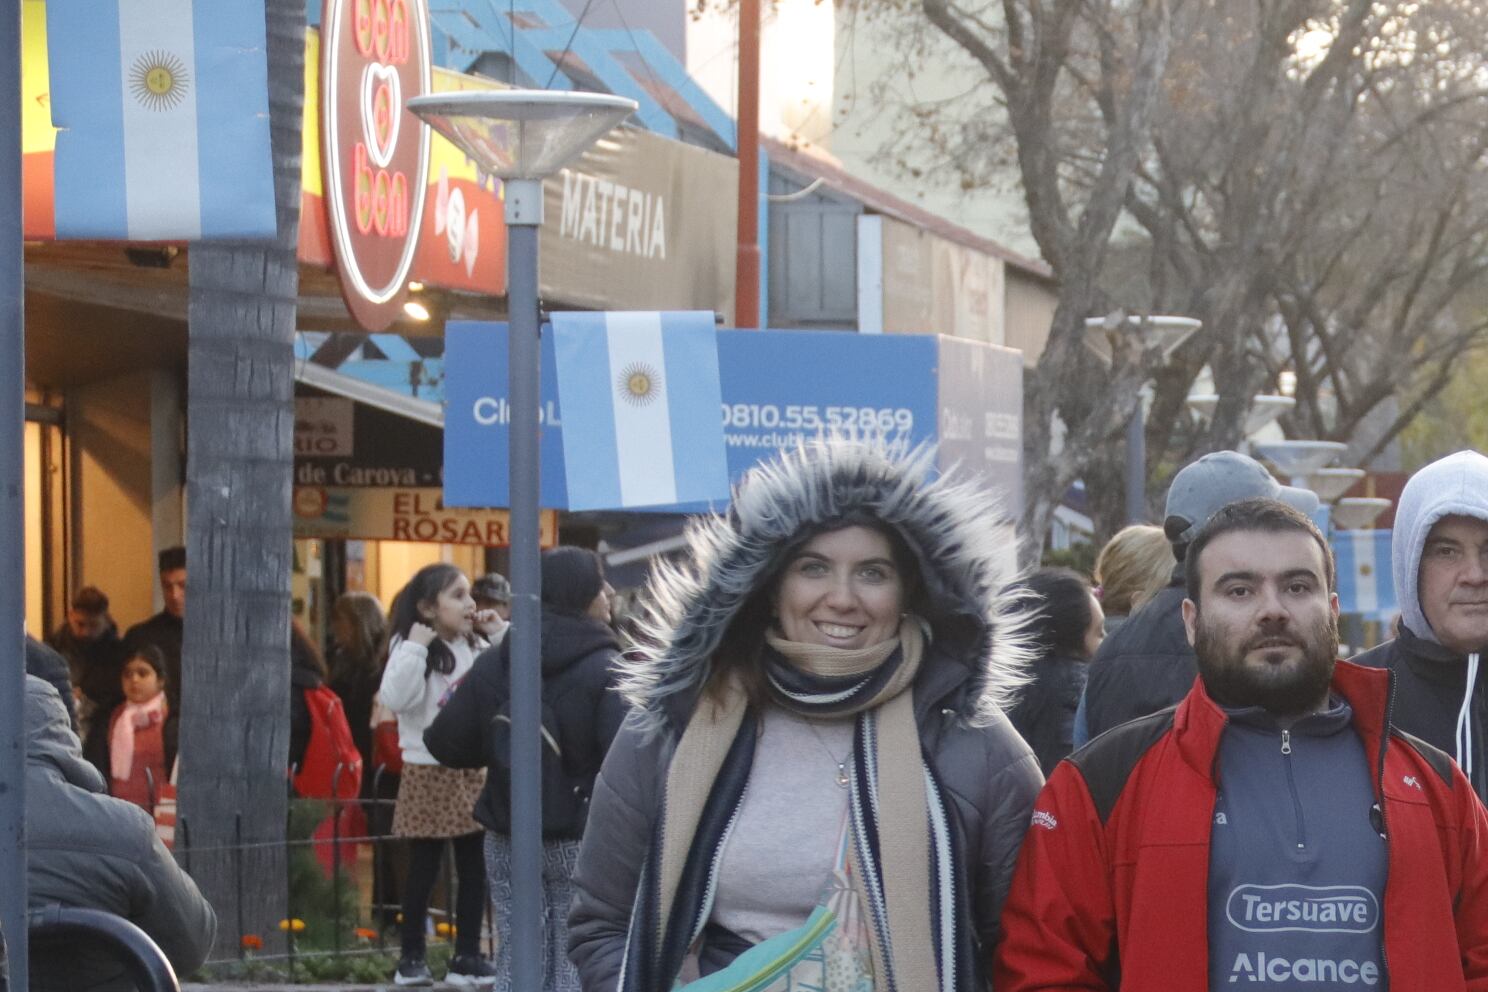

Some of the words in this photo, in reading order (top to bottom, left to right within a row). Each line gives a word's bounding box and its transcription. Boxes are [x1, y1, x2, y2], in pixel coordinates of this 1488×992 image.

[355, 0, 410, 64] bon
[354, 142, 408, 237] bon
[559, 172, 667, 260] MATERIA
[473, 397, 544, 426] Cl
[298, 464, 326, 483] de
[393, 493, 429, 515] EL
[393, 518, 543, 544] ROSAR
[1242, 894, 1367, 923] Tersuave
[1228, 951, 1379, 985] Alcance
